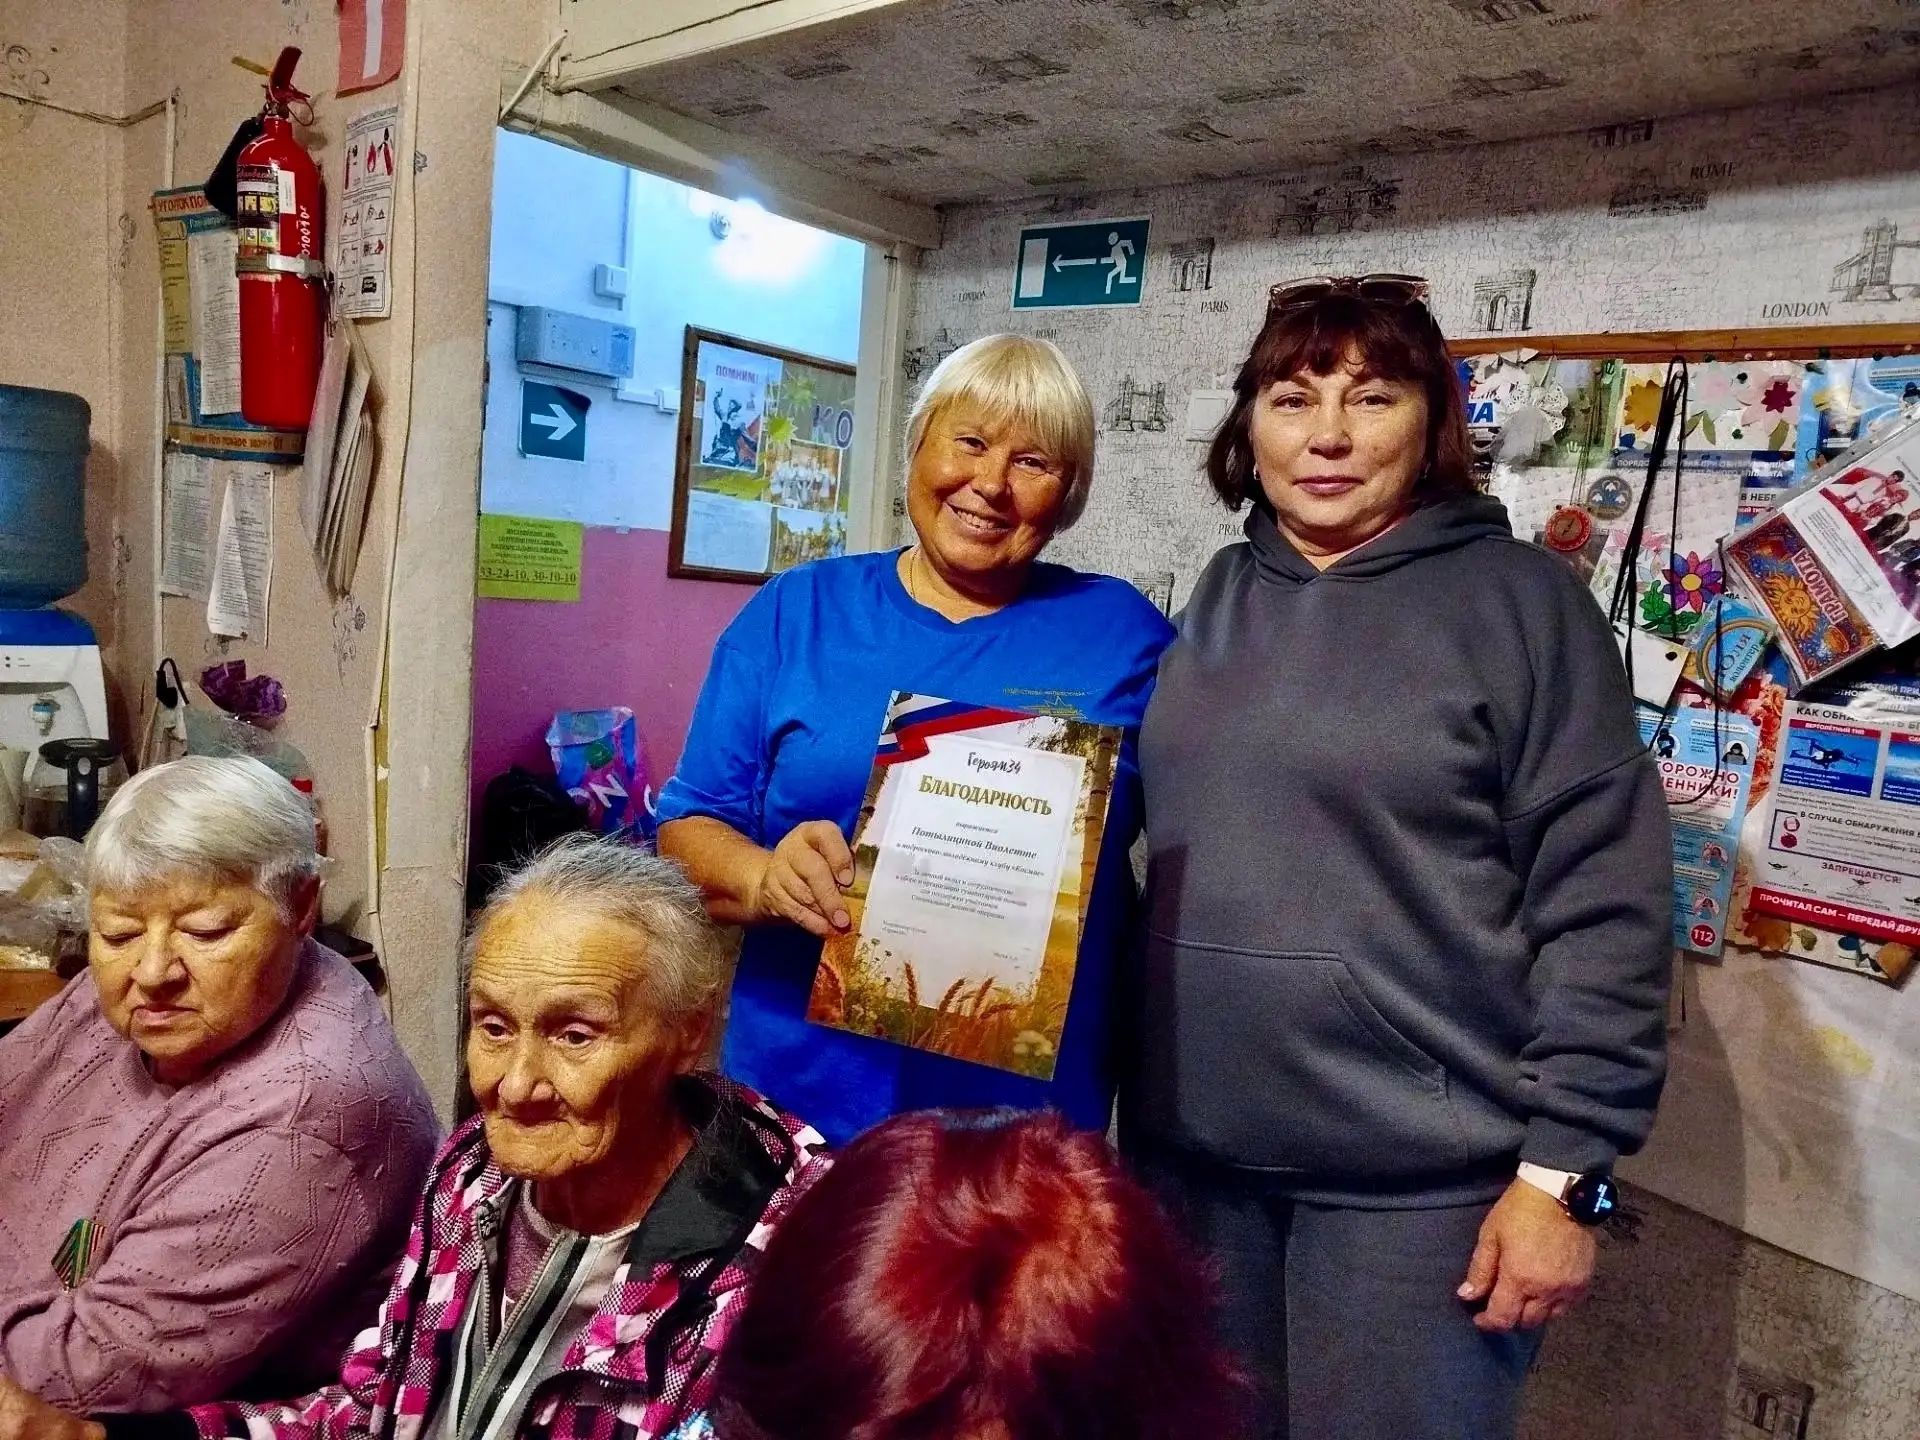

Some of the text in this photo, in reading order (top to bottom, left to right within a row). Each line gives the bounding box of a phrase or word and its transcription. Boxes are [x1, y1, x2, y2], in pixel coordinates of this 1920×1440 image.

[1763, 301, 1832, 319] LONDON
[716, 365, 759, 384] ПОМНИМ!
[1218, 523, 1245, 537] PRAG
[1793, 549, 1849, 624] ГРАМОТА
[1797, 706, 1820, 718] КАК
[968, 752, 1022, 775] Героям34
[919, 774, 1052, 816] БЛАГОДАРНОСТЬ
[1661, 776, 1738, 799] ЕННИКИ!
[1808, 813, 1843, 824] СЛУЧАЕ
[1845, 819, 1915, 836] ОБНАРУЖЕНИЯ
[1822, 861, 1902, 884] ЗАПРЕЩАЕТСЯ!
[1759, 893, 1812, 912] ПРОЧИТАЛ
[1813, 905, 1837, 917] САМ
[1847, 911, 1896, 931] ПЕРЕДАЙ
[1693, 929, 1714, 943] 112
